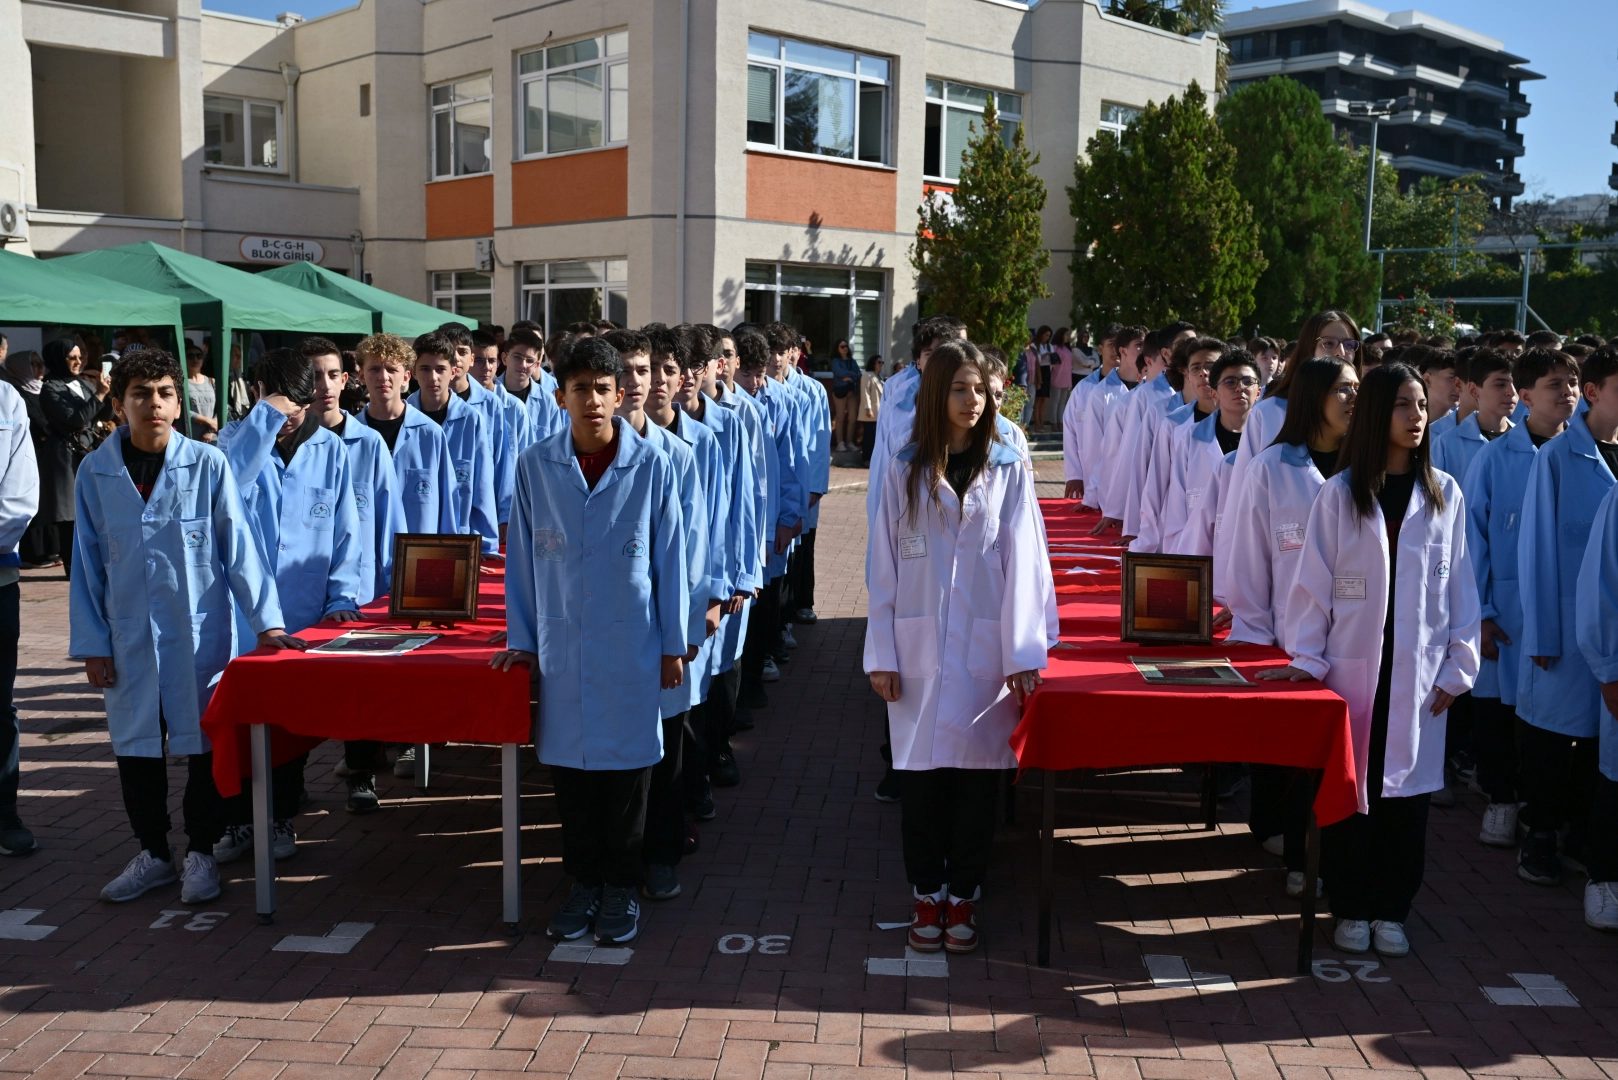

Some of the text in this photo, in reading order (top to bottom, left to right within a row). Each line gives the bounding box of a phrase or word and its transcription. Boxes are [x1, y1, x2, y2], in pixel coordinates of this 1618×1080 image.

[262, 239, 304, 250] B-C-G-H
[251, 249, 280, 259] BLOK
[718, 933, 791, 954] 30
